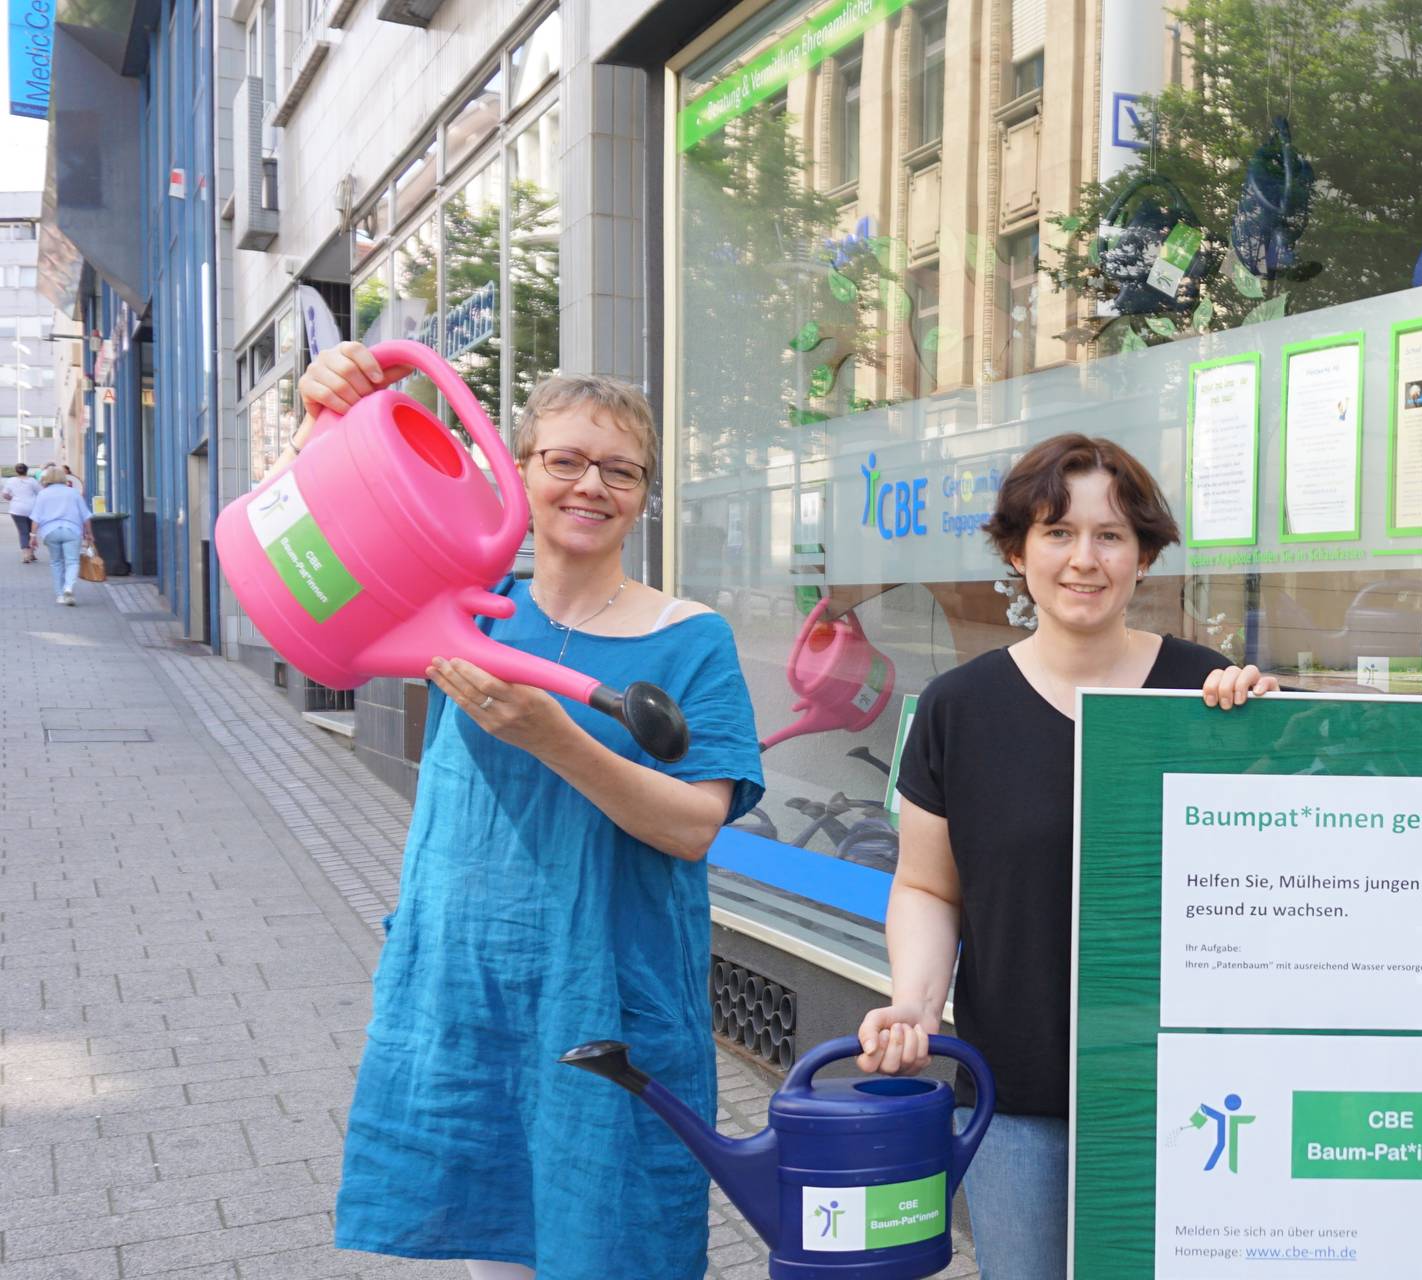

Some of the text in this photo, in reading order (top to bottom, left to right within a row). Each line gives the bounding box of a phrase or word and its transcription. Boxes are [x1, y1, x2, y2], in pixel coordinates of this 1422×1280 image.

[707, 91, 741, 120] Beratung
[741, 77, 751, 99] &
[750, 46, 800, 91] Vermittlung
[877, 475, 929, 540] CBE
[305, 550, 323, 571] CBE
[1187, 873, 1240, 888] Helfen
[1245, 874, 1274, 890] Sie,
[1279, 874, 1360, 890] Mülheims
[1364, 876, 1420, 893] jungen
[1186, 902, 1349, 918] gesund zu wachsen.
[1185, 944, 1242, 954] Ihr Aufgabe:
[1185, 960, 1209, 969] Ihren
[1276, 962, 1291, 970] mit
[1294, 962, 1349, 971] ausreichend
[1351, 963, 1385, 971] Wasser
[1368, 1111, 1414, 1129] CBE
[898, 1199, 919, 1211] CBE
[1175, 1225, 1358, 1238] Melden Sie sich an über unsere
[1175, 1246, 1357, 1259] Homepage: www.cbe-mh.de
